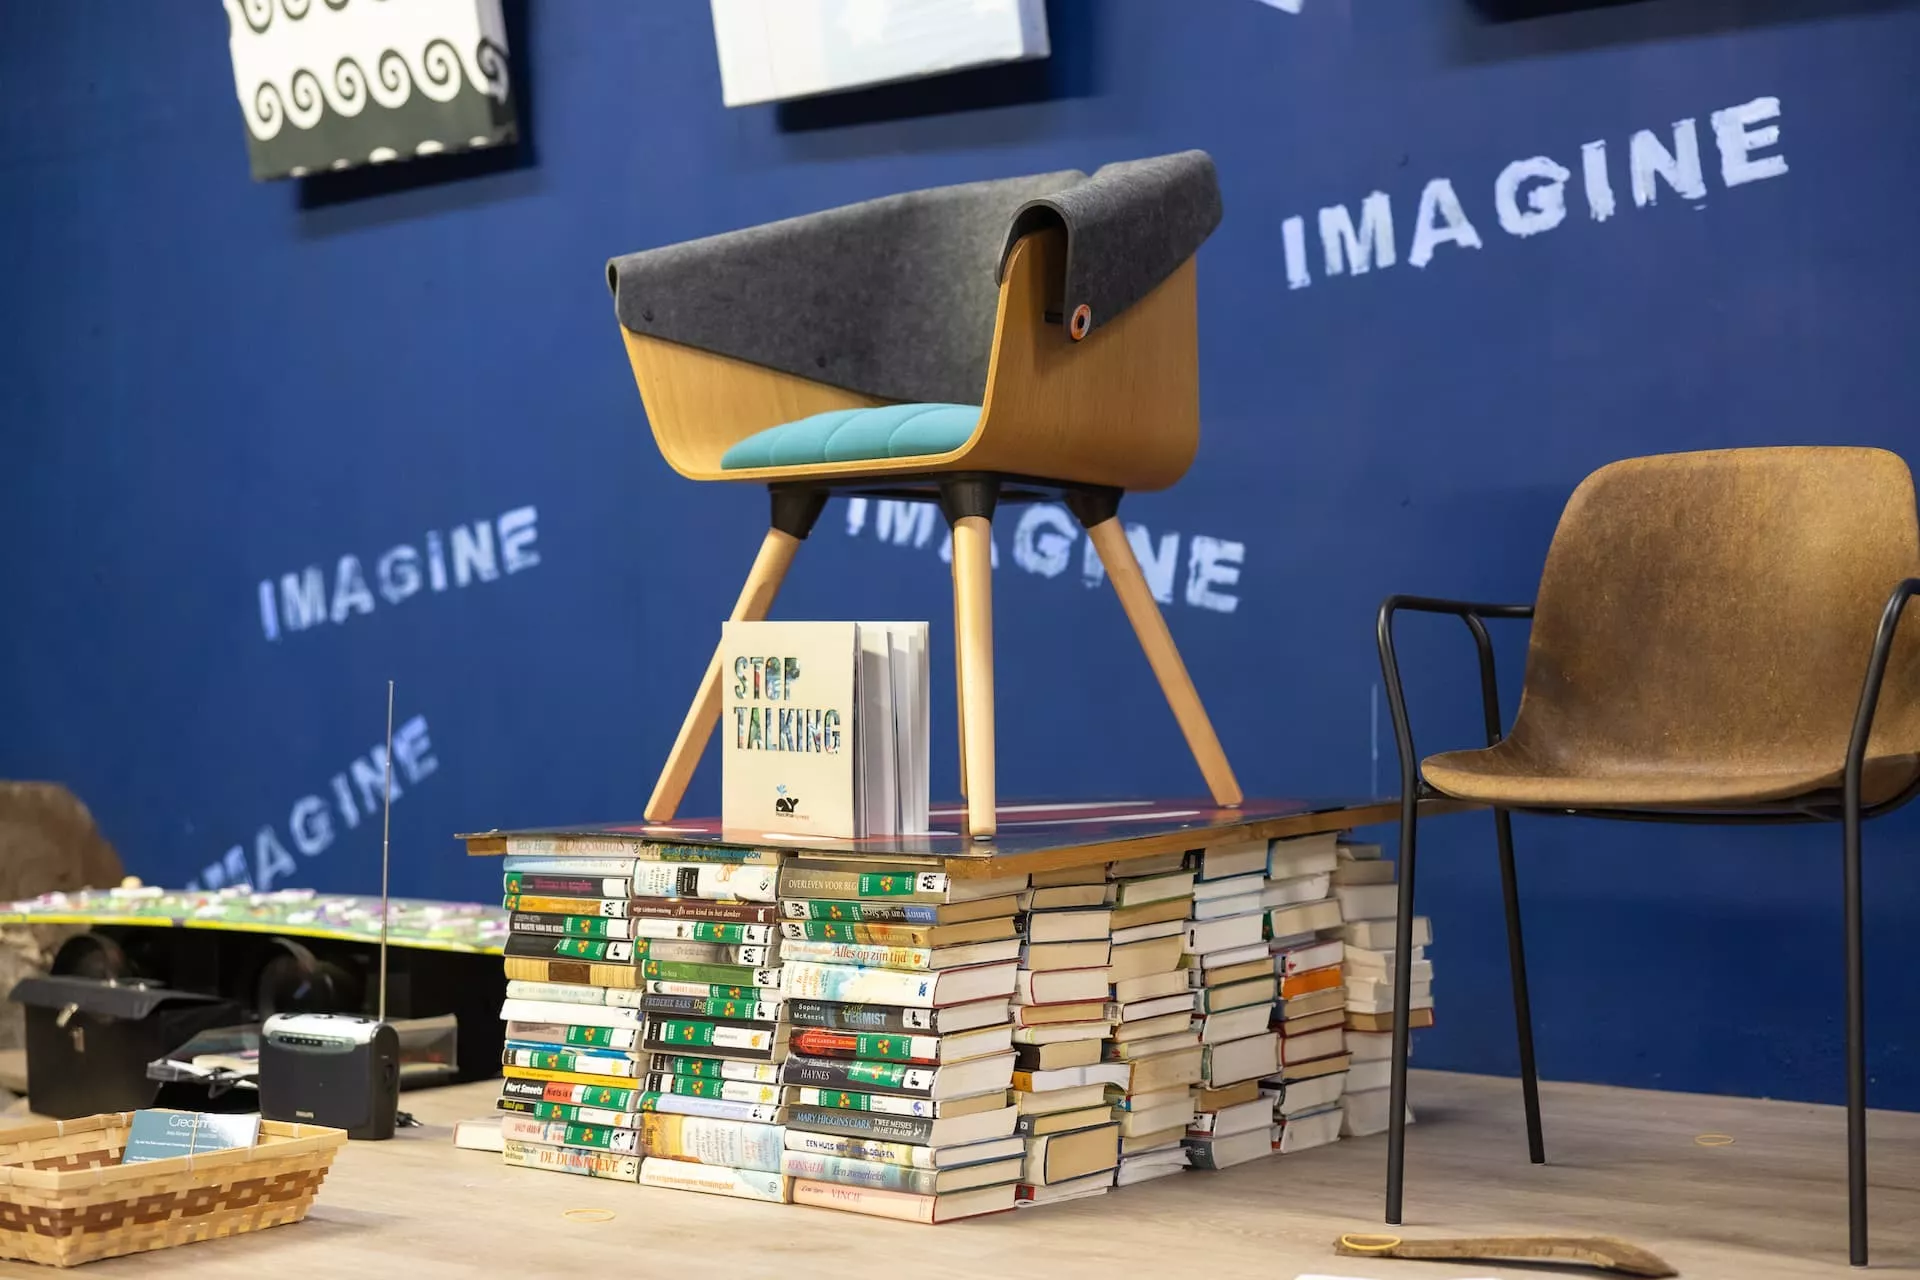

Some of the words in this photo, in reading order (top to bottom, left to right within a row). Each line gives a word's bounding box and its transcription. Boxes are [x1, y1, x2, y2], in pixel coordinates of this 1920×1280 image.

[1282, 97, 1788, 289] IMAGINE
[846, 497, 1245, 613] IMGINE
[258, 505, 541, 642] IMAGINE
[734, 656, 801, 701] STOP
[733, 707, 841, 755] TALKING
[186, 714, 439, 891] MAGINE
[788, 879, 824, 890] OVERLEVEN
[825, 881, 843, 890] VOOR
[695, 908, 707, 916] kind
[832, 946, 855, 959] Alles
[857, 950, 869, 962] op
[871, 950, 888, 962] zijn
[798, 1003, 820, 1012] Sophie
[794, 1012, 824, 1021] McKenzie
[844, 1012, 886, 1026] VERMIST
[801, 1069, 830, 1080] HAYNES
[796, 1113, 816, 1123] MARY
[817, 1114, 849, 1126] HIGGINS
[849, 1118, 872, 1129] CLARK
[874, 1119, 890, 1127] TWEE
[806, 1139, 818, 1148] EEN
[539, 1150, 554, 1163] DE
